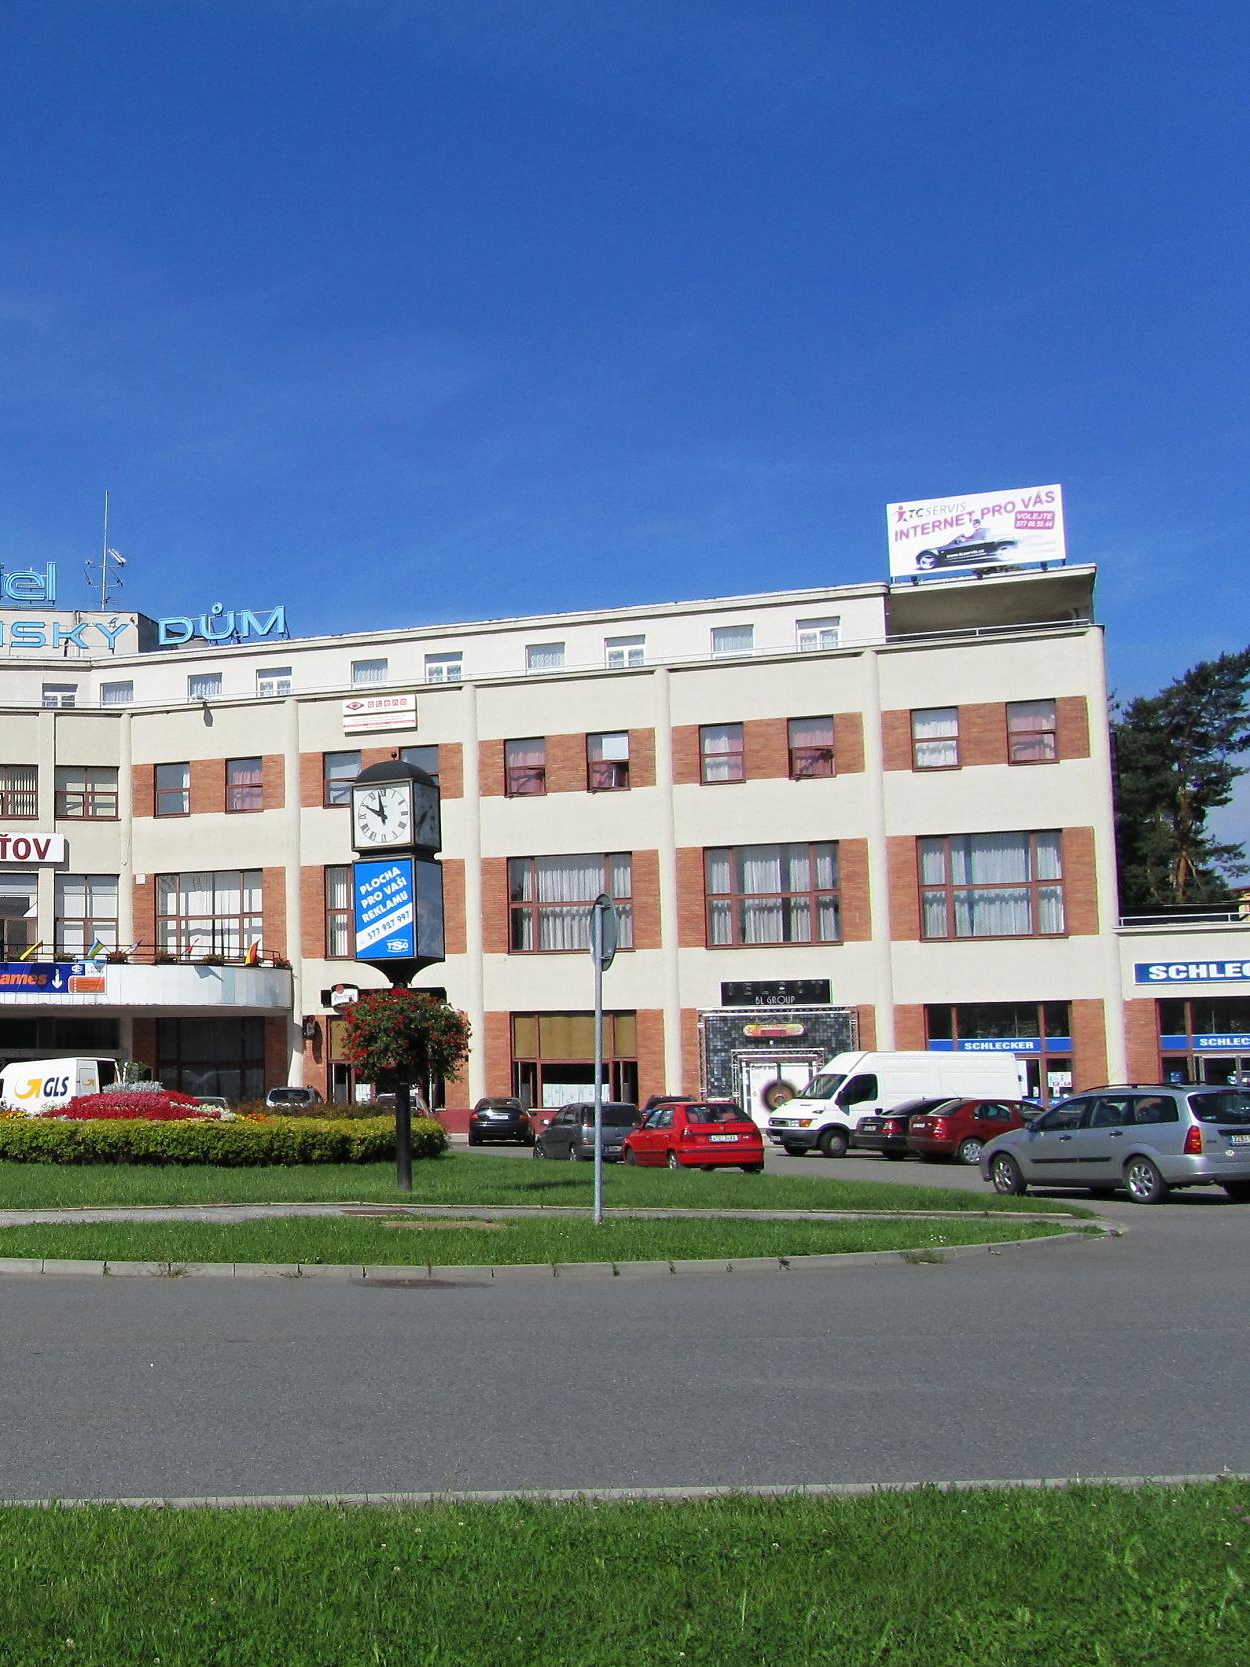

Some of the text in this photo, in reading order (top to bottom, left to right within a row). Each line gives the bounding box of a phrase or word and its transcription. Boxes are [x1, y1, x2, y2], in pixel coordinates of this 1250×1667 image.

[894, 491, 1055, 542] INTERNET PRO VÁS
[1016, 512, 1053, 520] VOLEJTE
[158, 602, 286, 645] DŮM
[359, 866, 401, 895] PLOCHA
[361, 876, 408, 909] PRO VAŠI
[361, 890, 408, 923] REKLAMU
[397, 910, 410, 922] 997
[766, 995, 795, 1005] GROUP
[964, 1041, 1034, 1050] SCHLECKER
[43, 1076, 69, 1097] GLS
